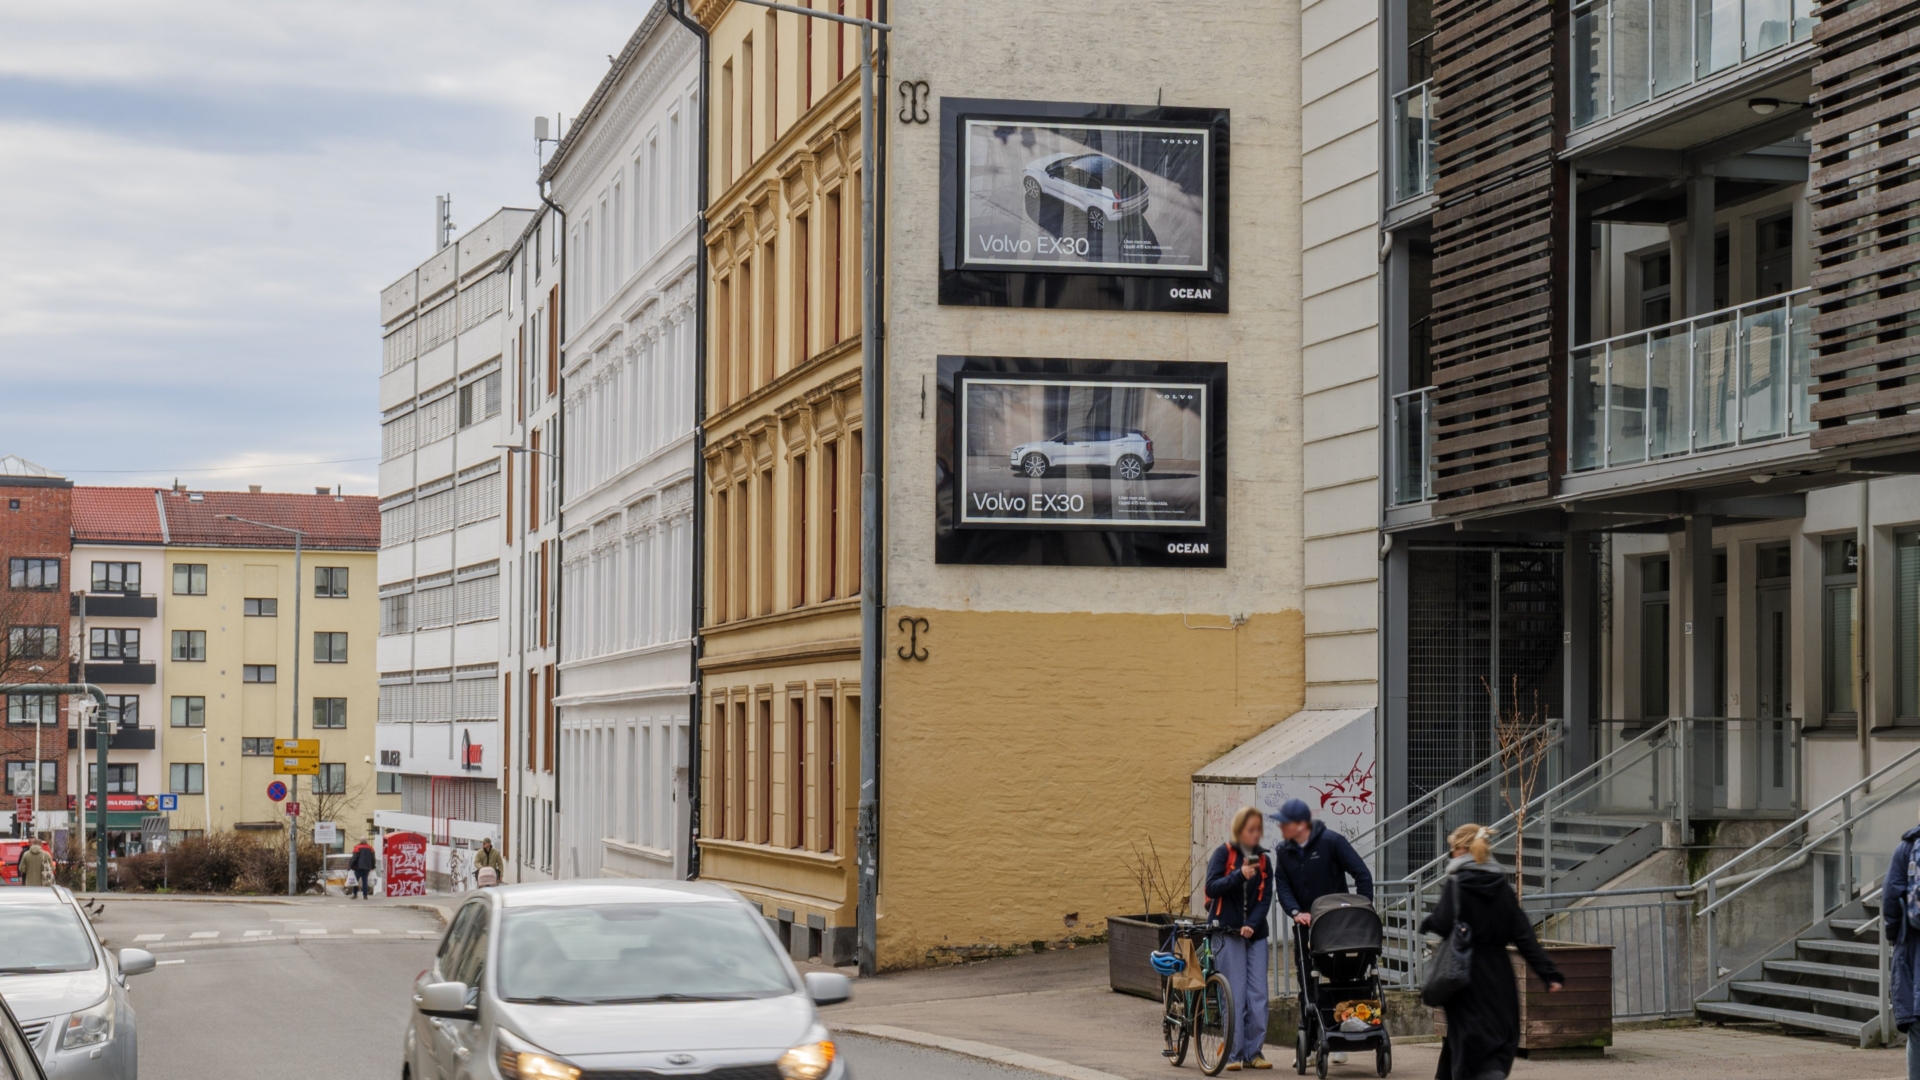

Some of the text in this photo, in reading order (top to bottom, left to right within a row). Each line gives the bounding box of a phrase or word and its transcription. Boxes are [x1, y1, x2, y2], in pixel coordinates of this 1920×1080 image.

[979, 234, 1090, 255] Volvo EX30
[1170, 288, 1212, 299] OCEAN
[973, 492, 1084, 512] Volvo EX30
[1168, 543, 1209, 553] OCEAN
